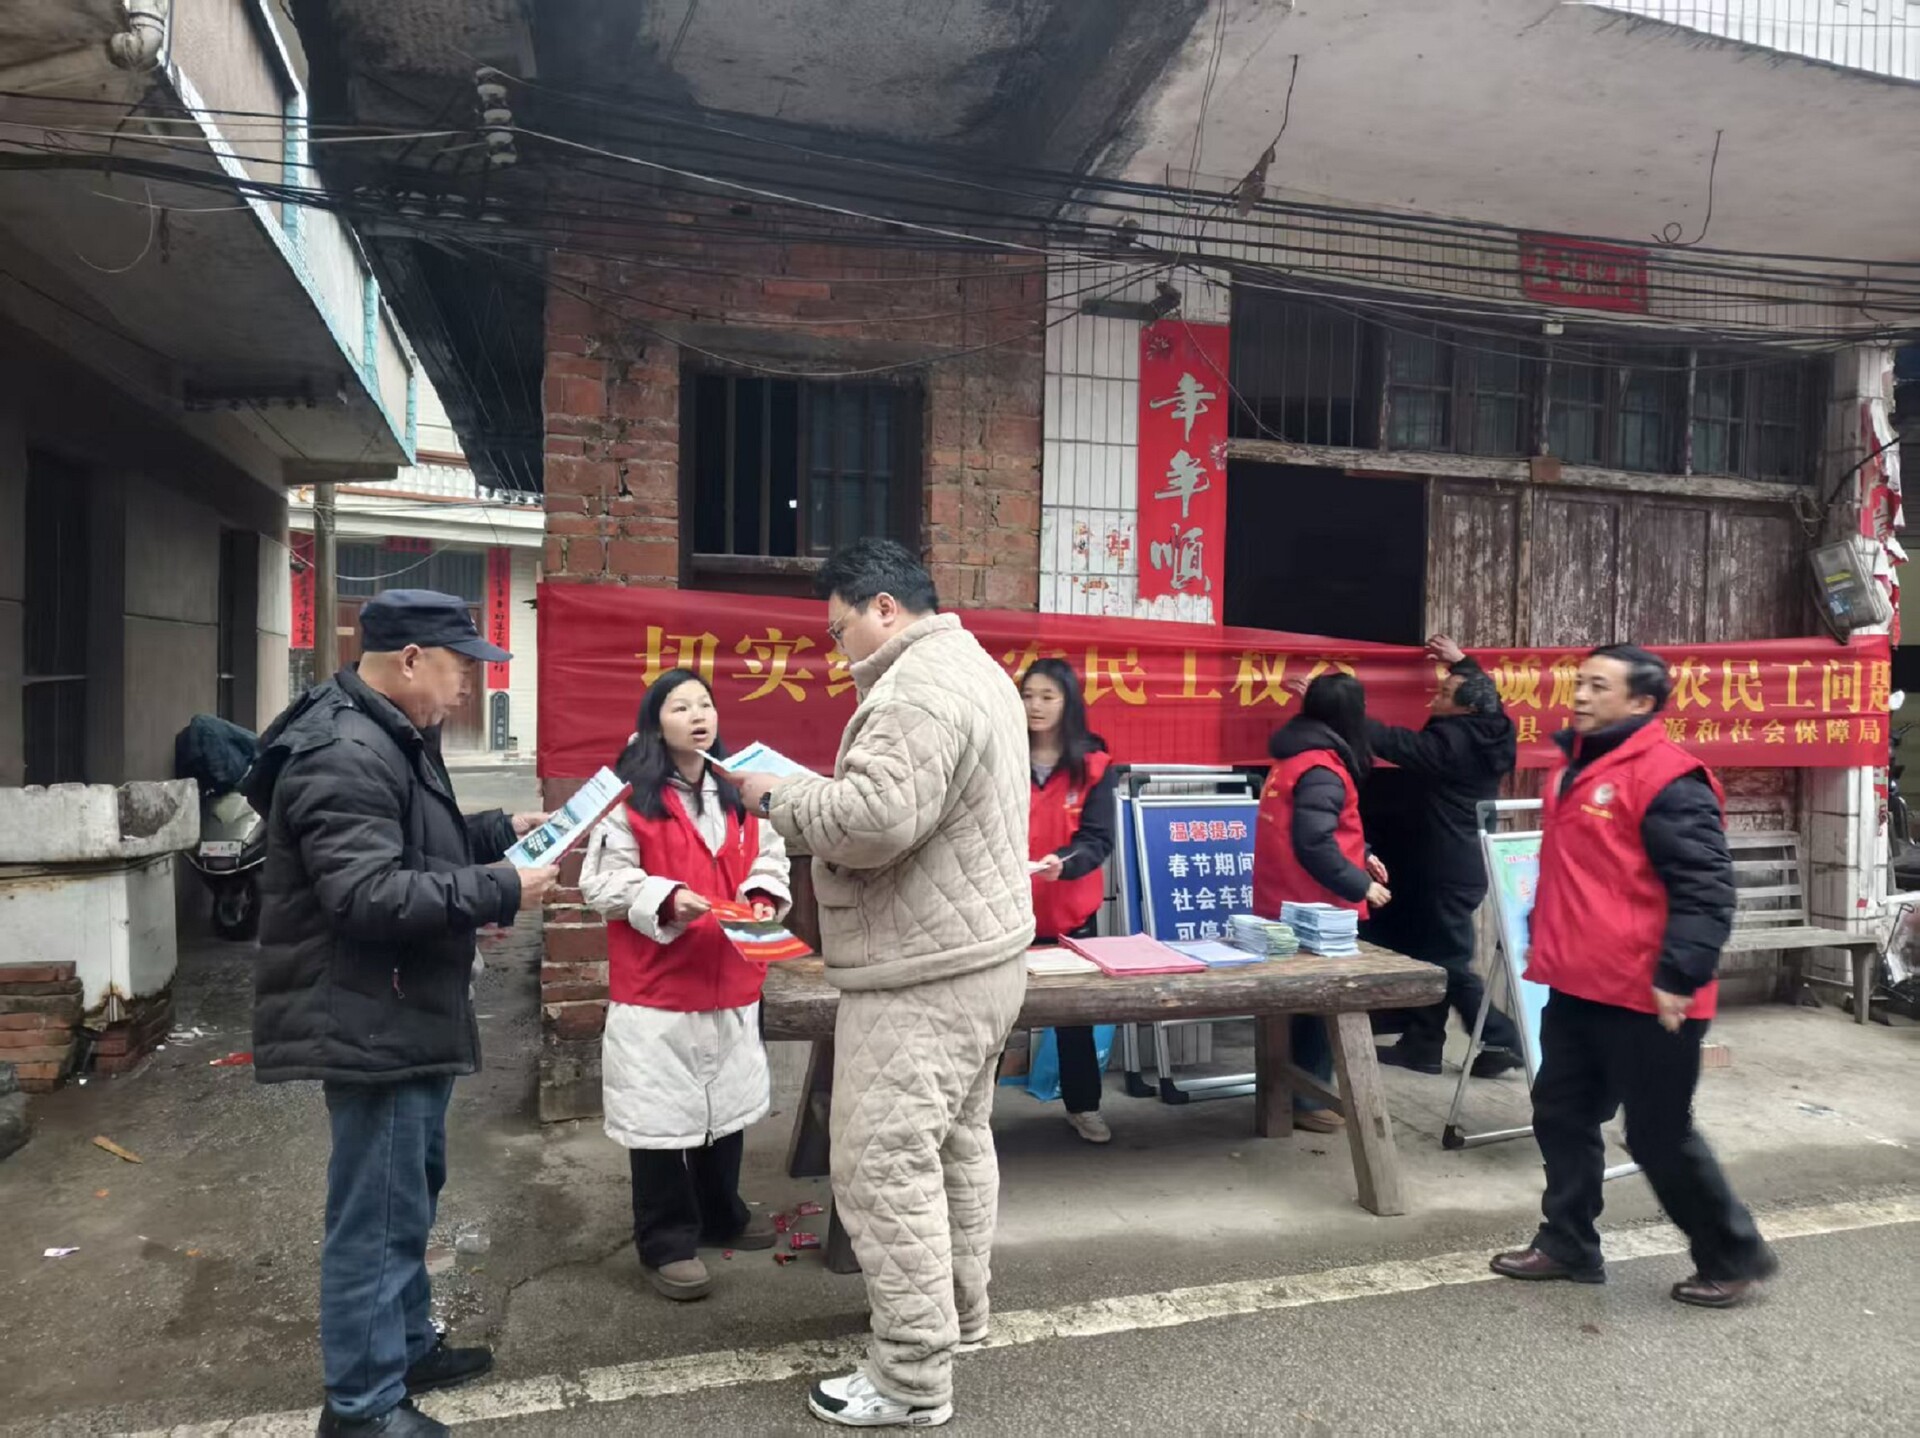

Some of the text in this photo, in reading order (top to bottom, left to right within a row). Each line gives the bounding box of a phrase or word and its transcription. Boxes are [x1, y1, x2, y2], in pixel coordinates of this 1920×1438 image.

[1516, 715, 1882, 744] 县源和社会保障局
[1169, 820, 1247, 842] 温馨提示
[1168, 852, 1254, 878] 春节期间
